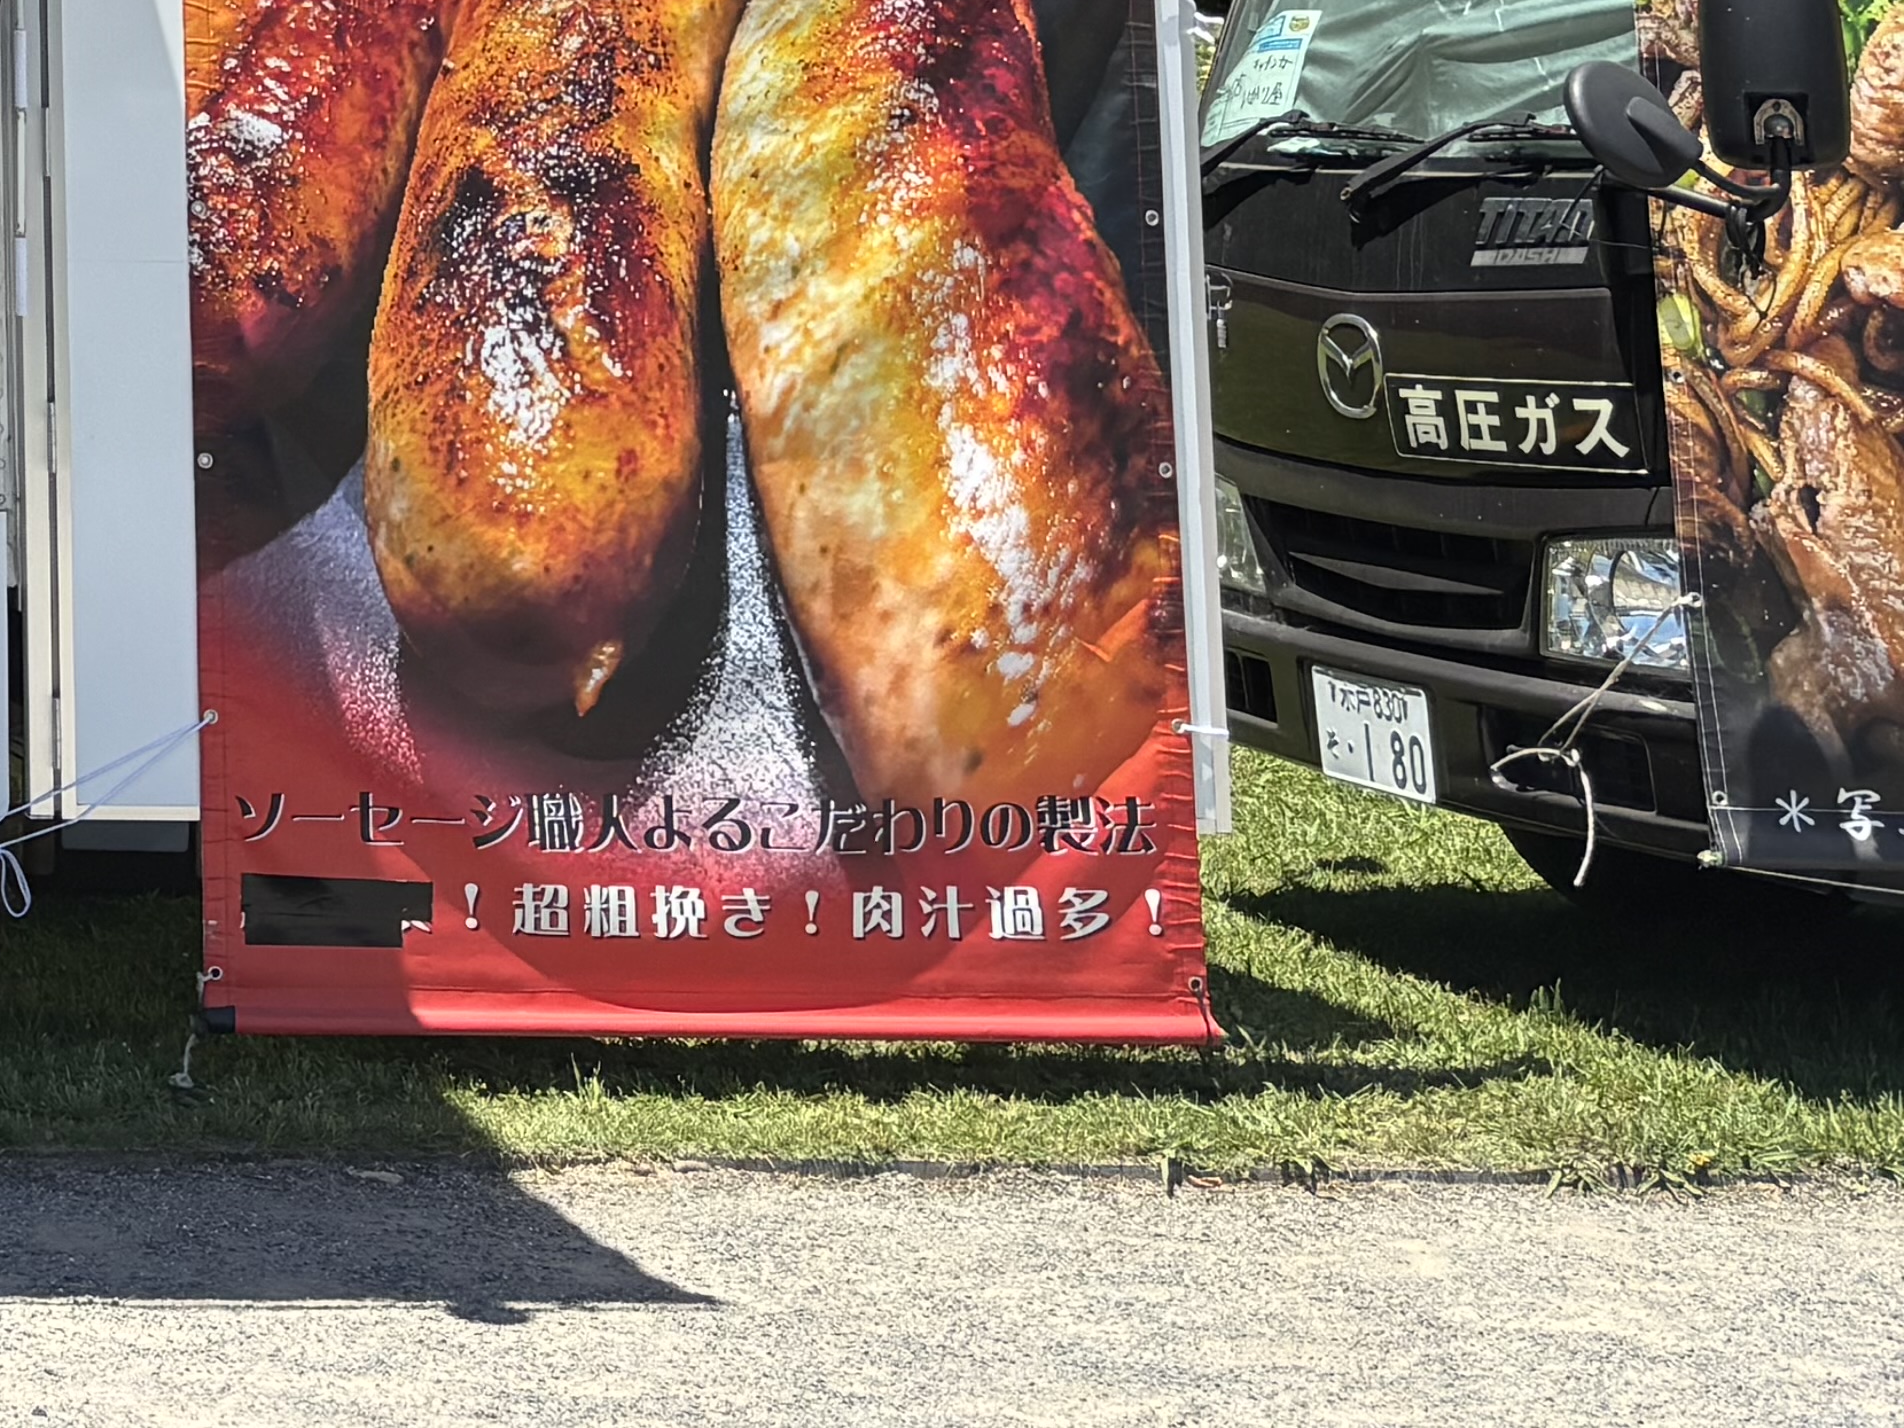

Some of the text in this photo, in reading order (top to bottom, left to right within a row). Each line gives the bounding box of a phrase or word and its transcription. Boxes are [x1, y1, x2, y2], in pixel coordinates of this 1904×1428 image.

[1496, 249, 1560, 266] DASH
[1396, 382, 1632, 459] 高圧ガス
[237, 790, 1158, 857] ソーセージ職人よるこだわりの製法
